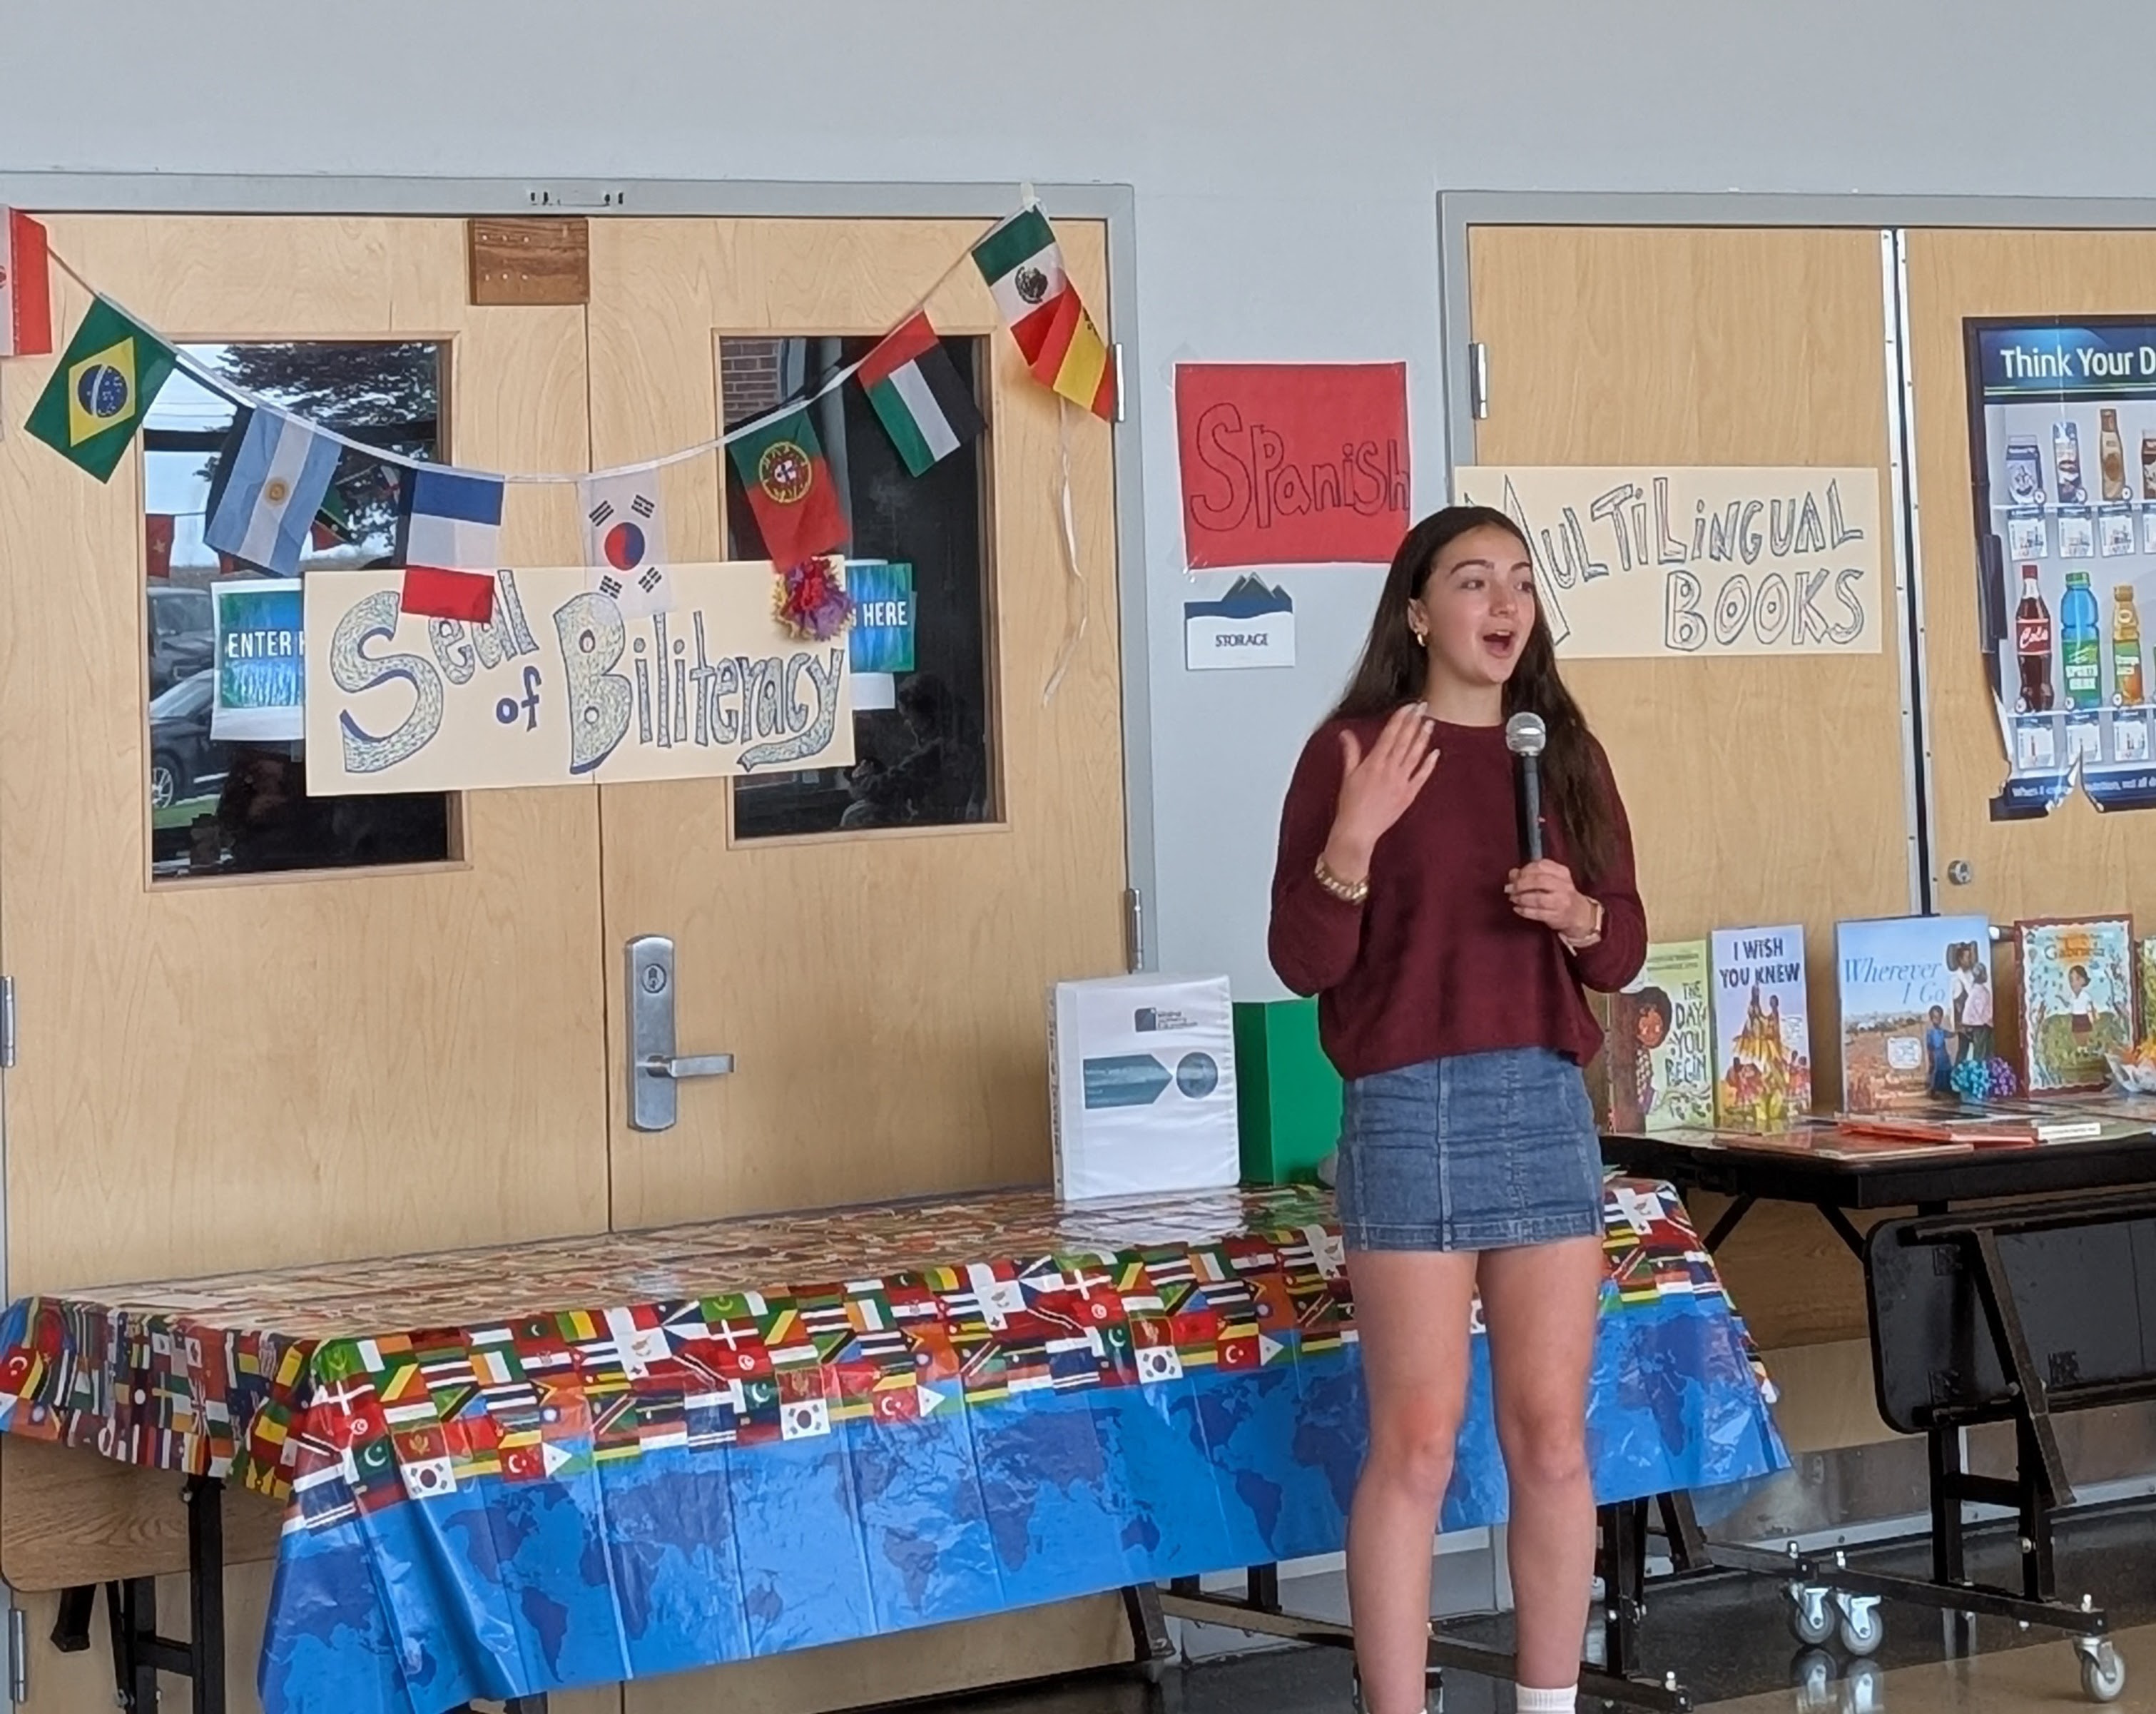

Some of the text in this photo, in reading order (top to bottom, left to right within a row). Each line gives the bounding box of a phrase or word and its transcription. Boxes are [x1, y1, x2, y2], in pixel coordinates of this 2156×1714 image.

[2000, 345, 2073, 377] Think
[2076, 348, 2134, 376] Your
[863, 601, 908, 627] HERE
[1664, 568, 1864, 651] BOOKS
[227, 630, 292, 658] ENTER
[1216, 633, 1268, 647] STORAGE
[330, 569, 540, 774] Seal
[496, 592, 845, 775] of Biliteracy
[1734, 941, 1739, 961] I
[1719, 963, 1801, 988] YOU KNEW
[1844, 957, 1943, 983] Wherever
[1682, 980, 1702, 1000] THE
[1902, 981, 1946, 1004] I Go
[1675, 1002, 1703, 1029] DAY
[1673, 1030, 1705, 1058] YOU
